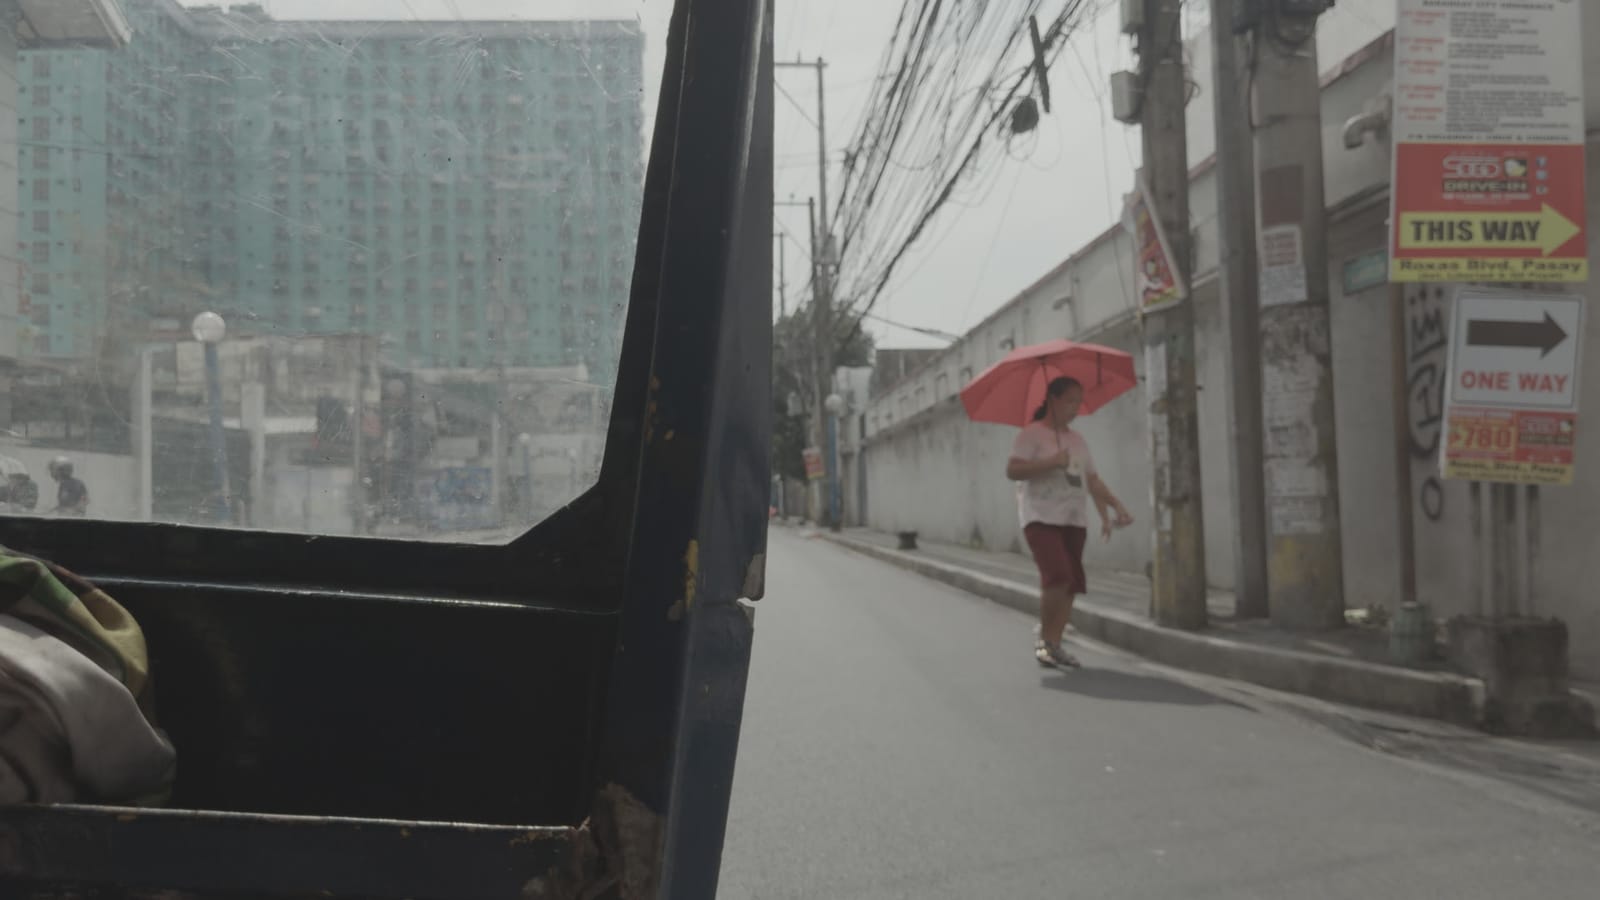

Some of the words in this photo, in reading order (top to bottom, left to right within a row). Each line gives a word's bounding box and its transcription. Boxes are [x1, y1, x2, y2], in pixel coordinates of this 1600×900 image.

[1411, 219, 1473, 242] THIS
[1480, 219, 1541, 242] WAY
[1400, 259, 1459, 271] Roxas
[1522, 259, 1581, 273] Pasay
[1460, 370, 1511, 391] ONE
[1517, 372, 1569, 394] WAY
